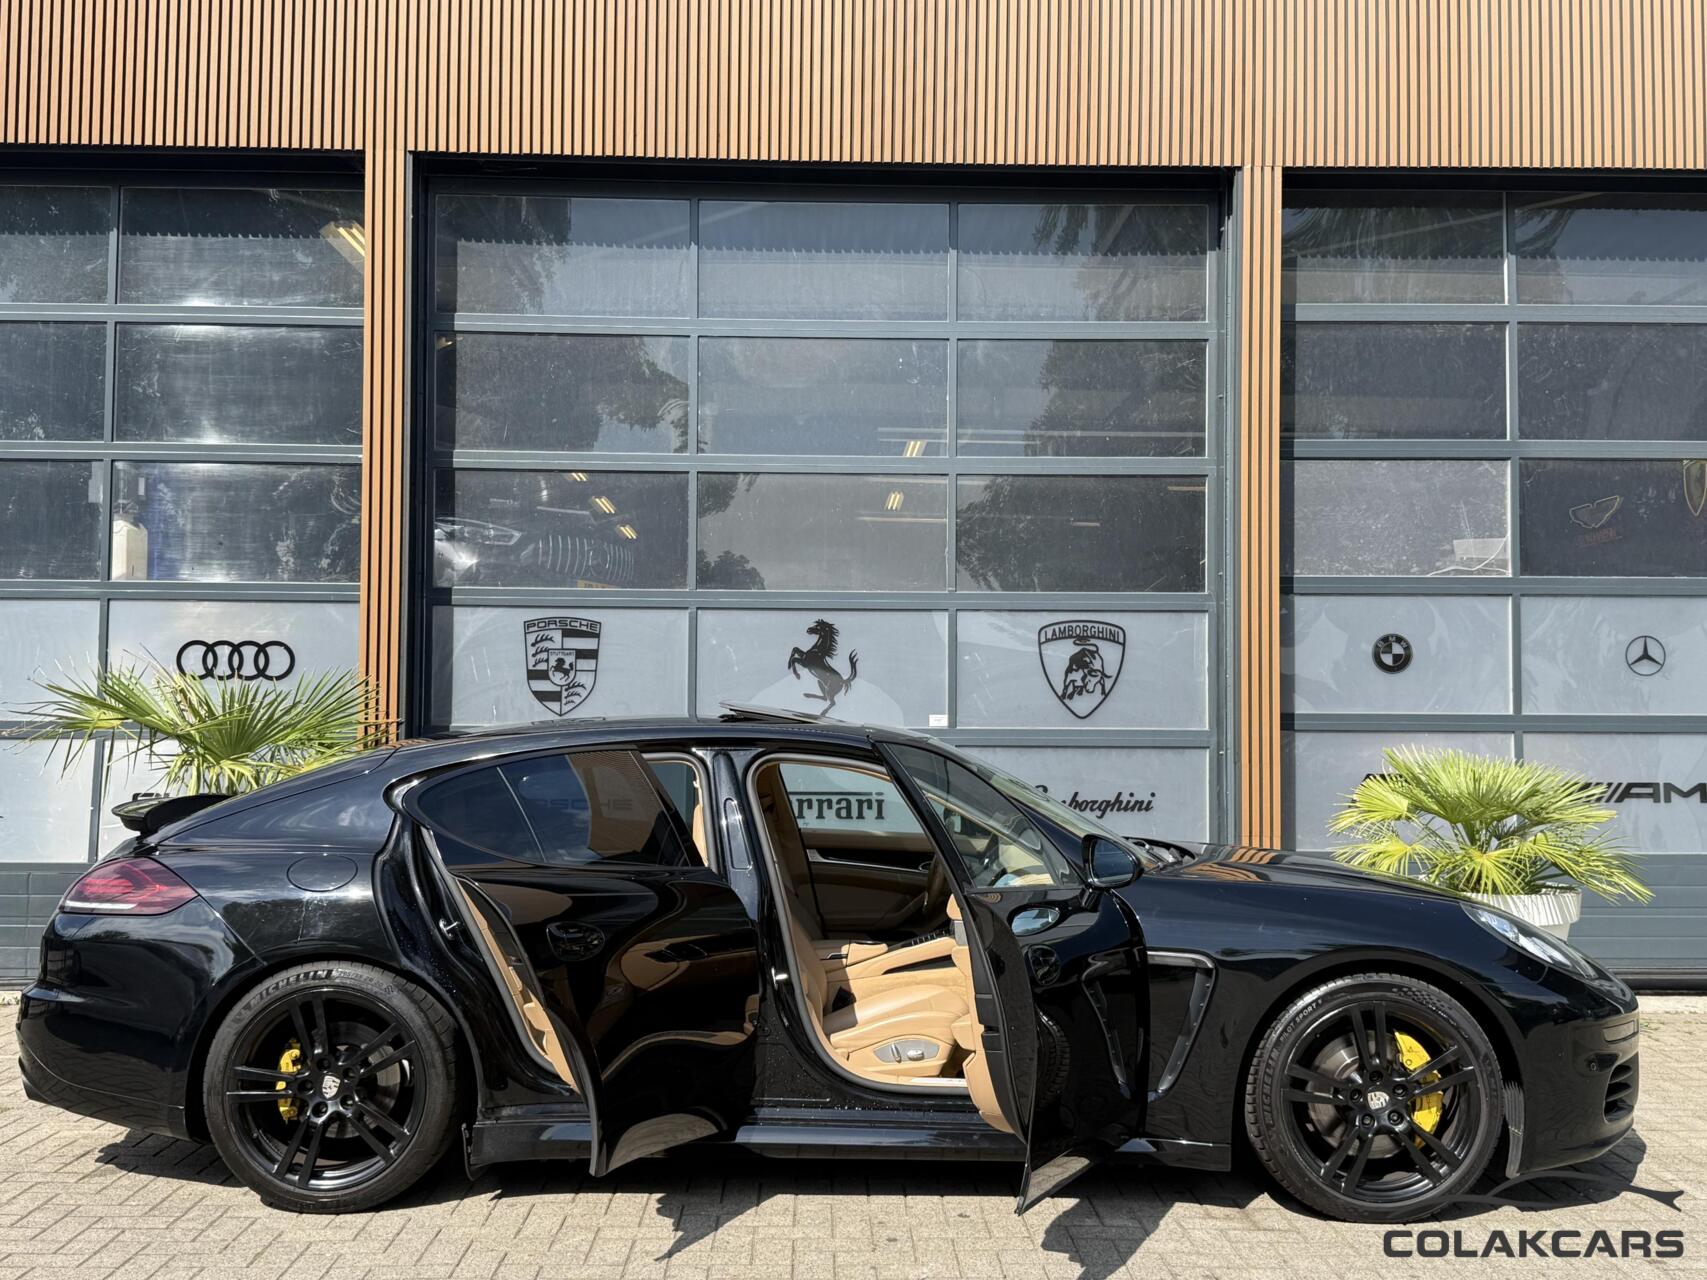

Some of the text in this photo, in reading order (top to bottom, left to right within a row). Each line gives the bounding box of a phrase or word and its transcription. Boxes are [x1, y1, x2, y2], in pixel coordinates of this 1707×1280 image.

[526, 619, 599, 632] PORSCHE
[1044, 624, 1120, 642] LAMBORGHINI
[795, 791, 886, 820] rrari
[249, 969, 328, 1008] MICHELIN
[1295, 1001, 1317, 1024] SPORT
